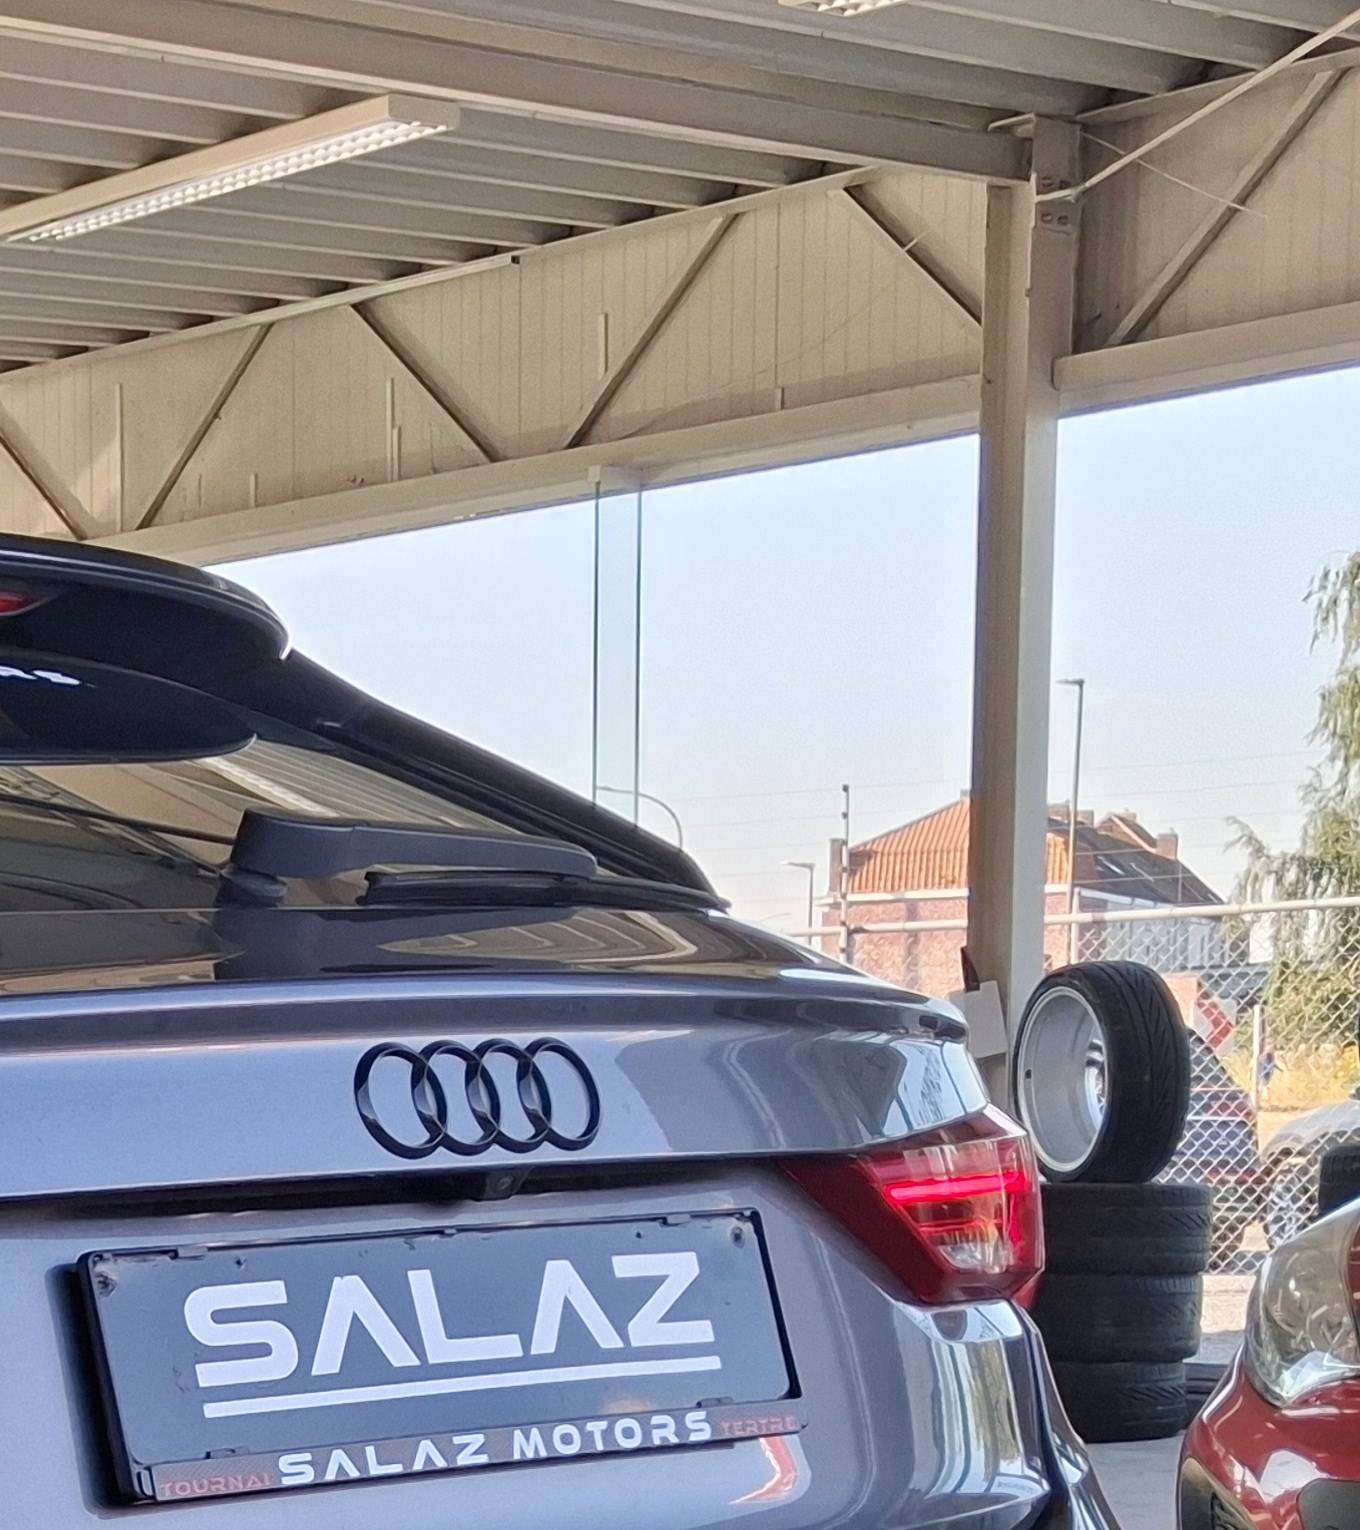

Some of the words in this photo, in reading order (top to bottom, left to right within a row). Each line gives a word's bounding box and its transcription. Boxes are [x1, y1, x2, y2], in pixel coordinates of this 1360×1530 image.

[184, 1251, 715, 1387] SALAZ
[160, 1472, 275, 1497] TOURNAI
[278, 1433, 489, 1485] SALAZ
[513, 1411, 712, 1460] MOTORS
